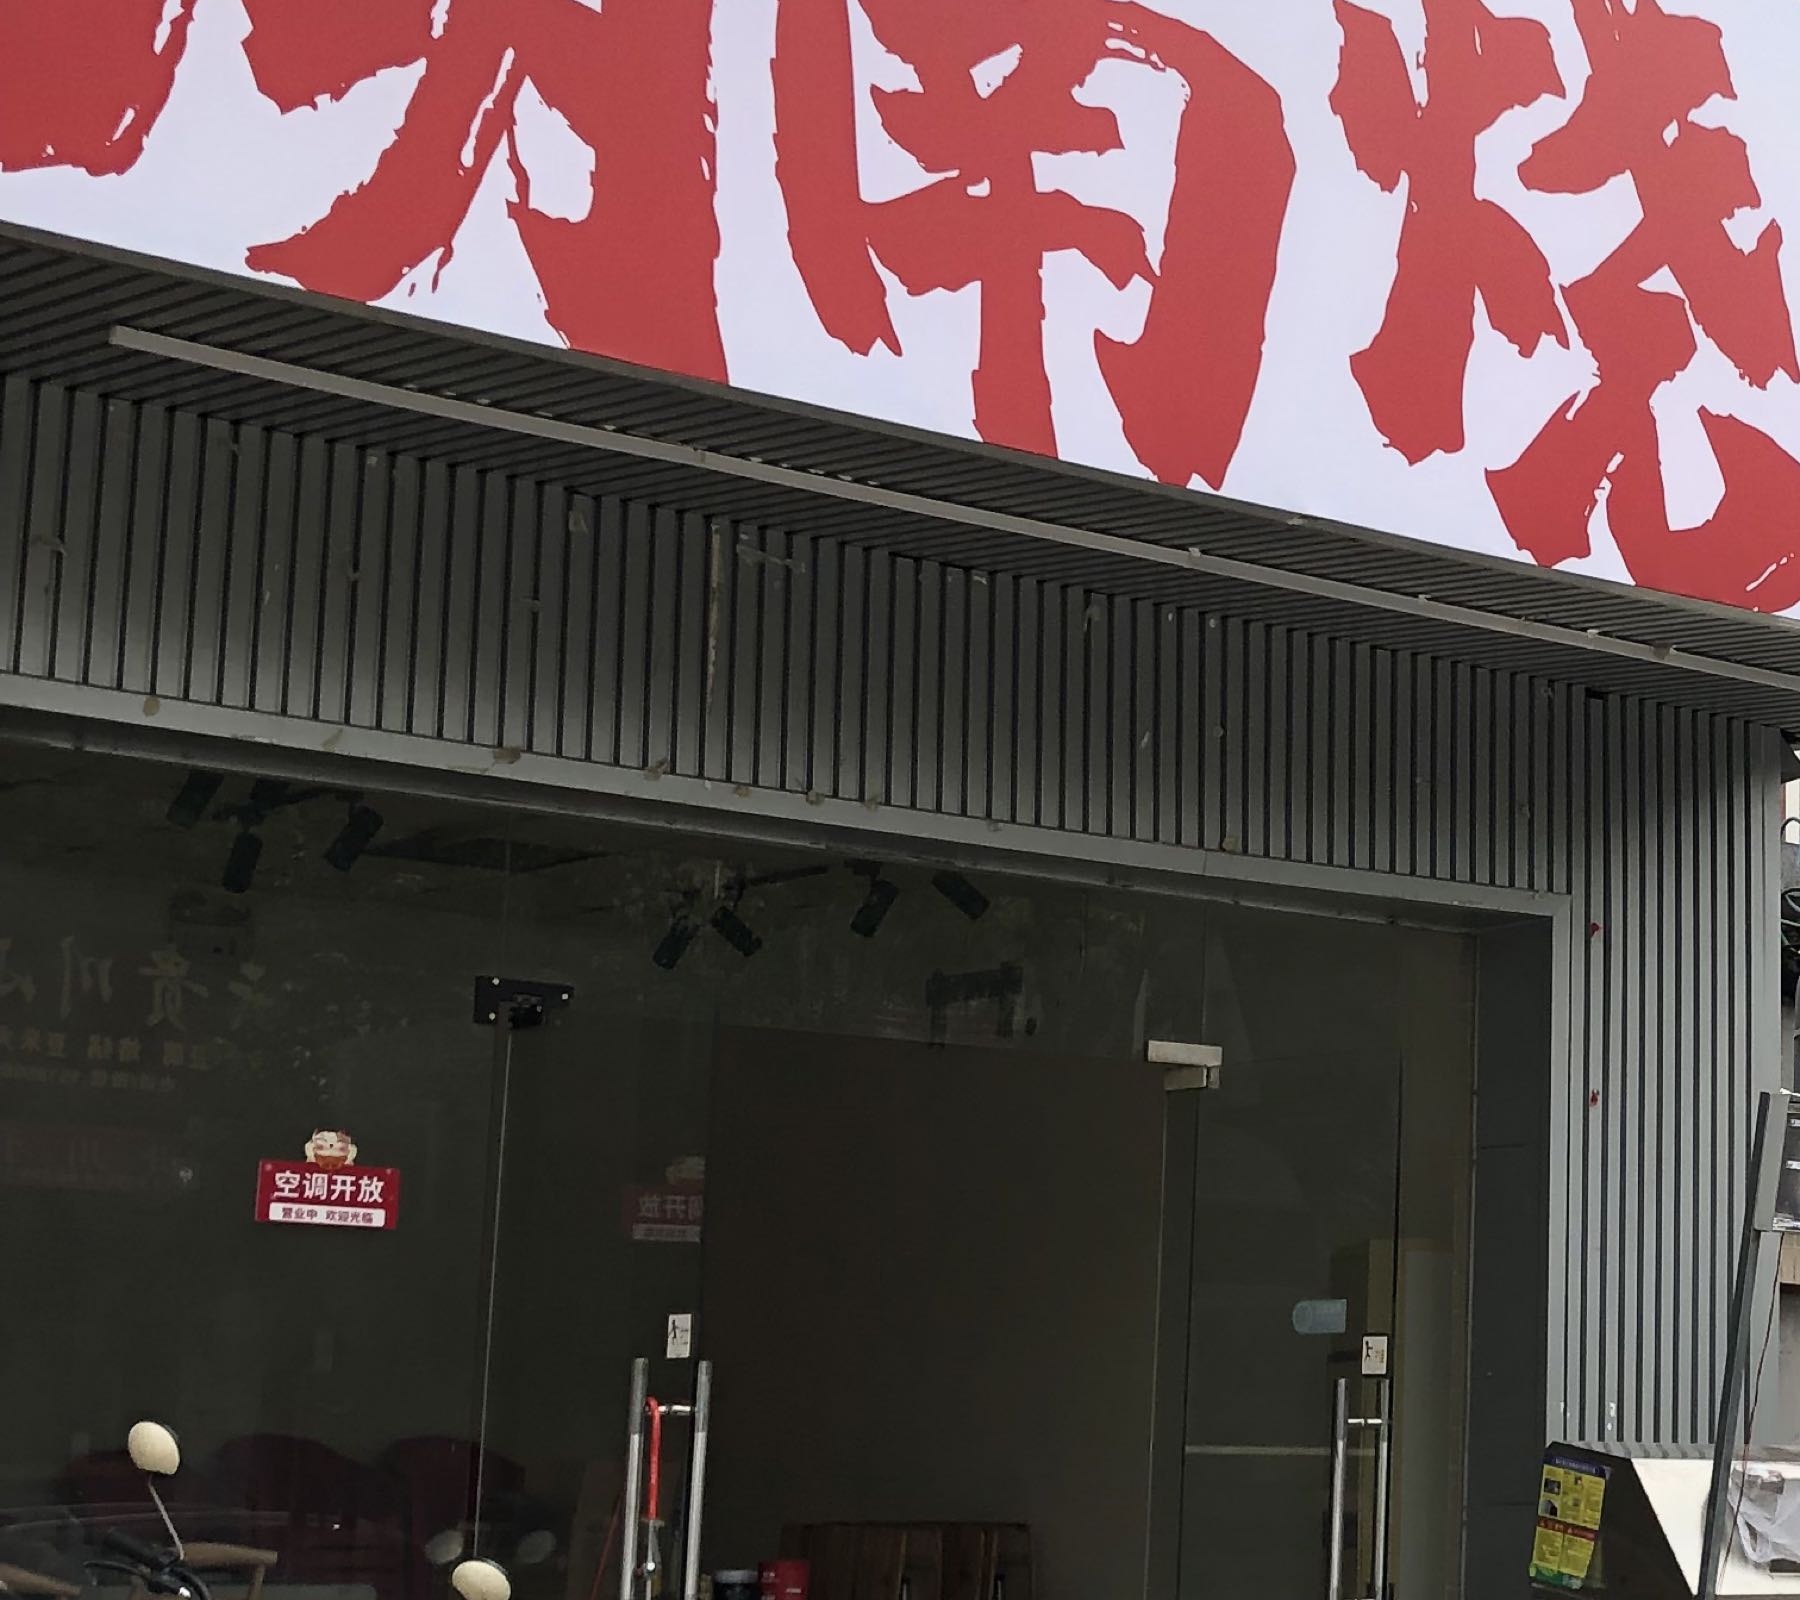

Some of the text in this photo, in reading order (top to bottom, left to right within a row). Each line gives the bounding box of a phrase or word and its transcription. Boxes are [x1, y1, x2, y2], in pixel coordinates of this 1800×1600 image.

[274, 1169, 385, 1203] 空调开放
[281, 1207, 374, 1224] 营业中 欢迎光临
